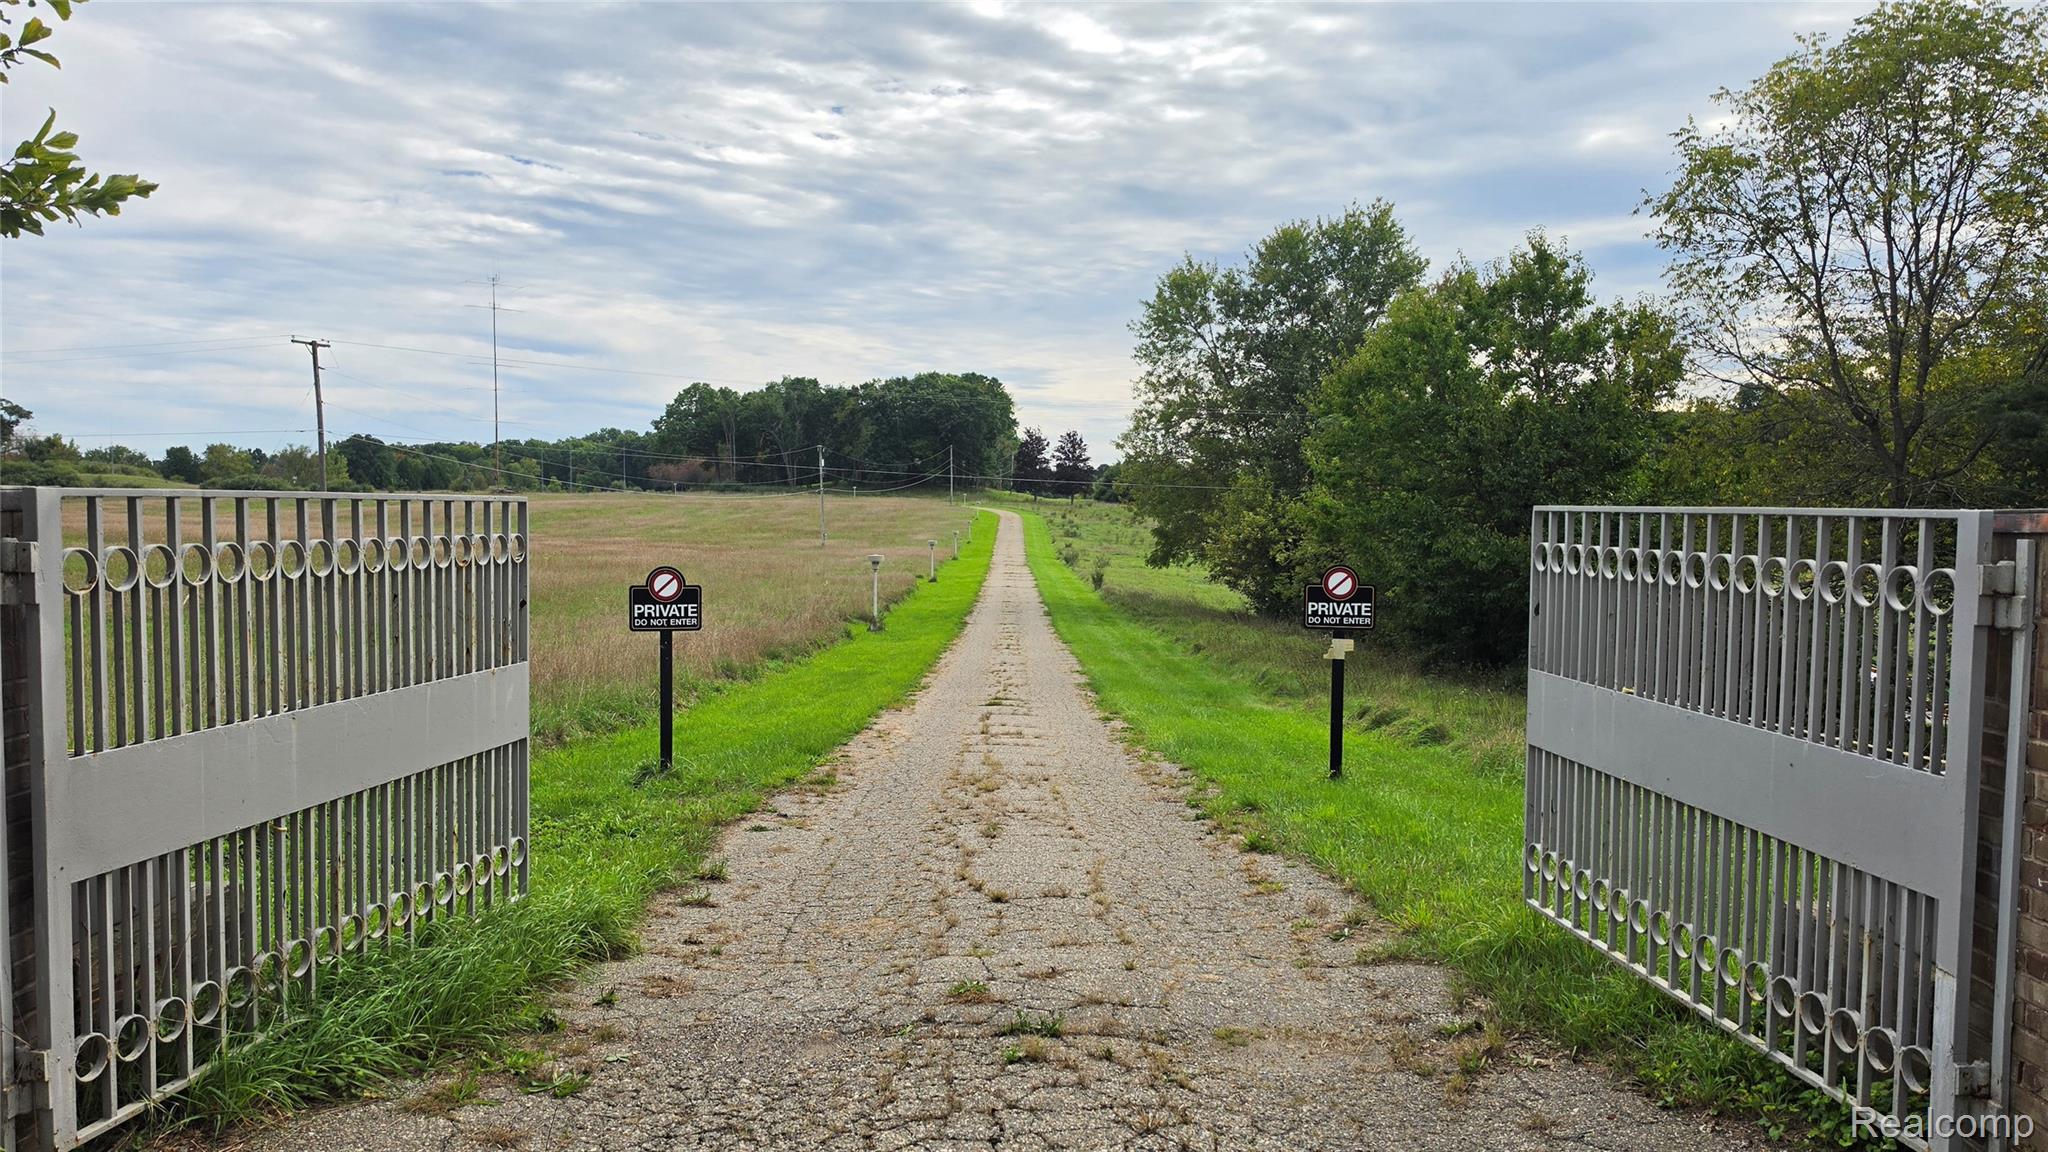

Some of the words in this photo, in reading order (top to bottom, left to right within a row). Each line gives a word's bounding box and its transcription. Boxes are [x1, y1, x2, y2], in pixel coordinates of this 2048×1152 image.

[634, 604, 698, 617] PRIVATE
[1308, 602, 1372, 616] PRIVATE
[670, 618, 698, 626] ENTER
[1343, 617, 1371, 625] ENTER
